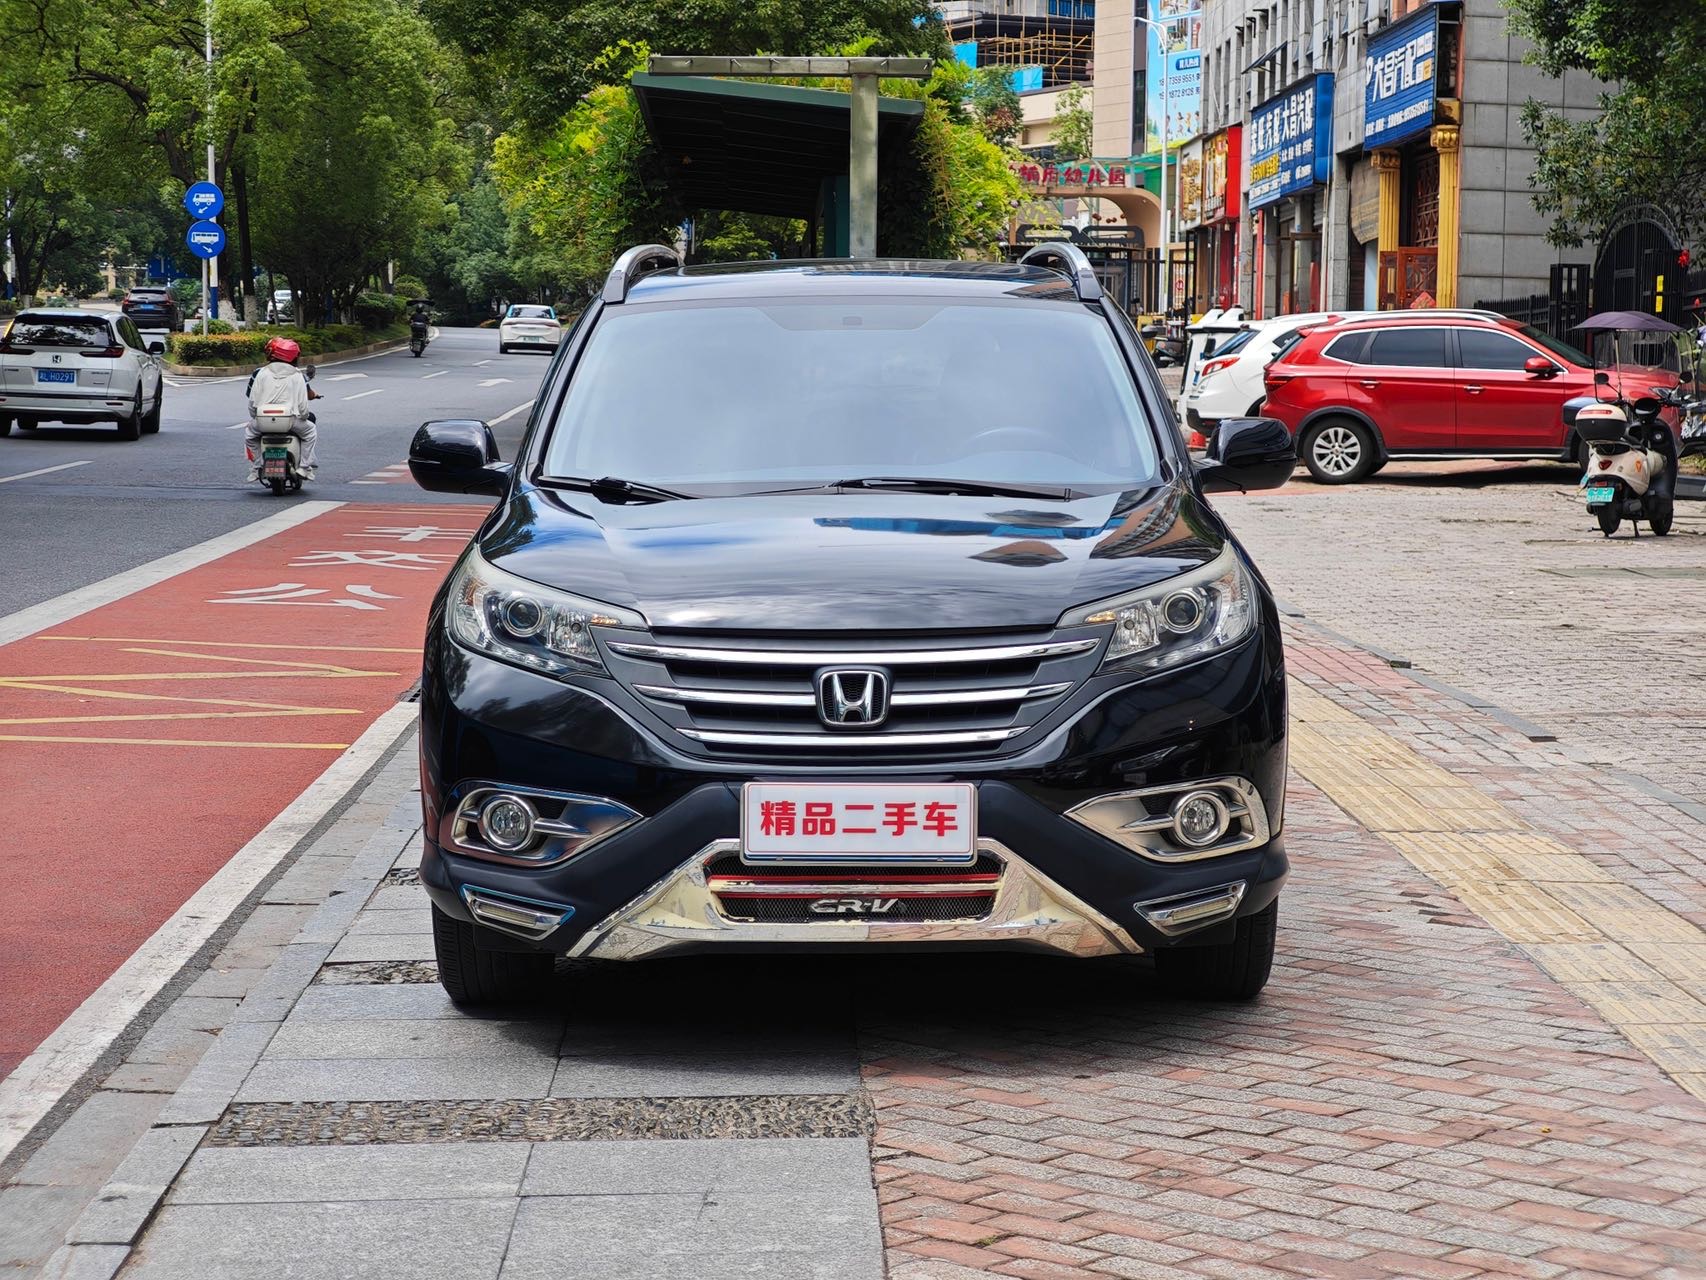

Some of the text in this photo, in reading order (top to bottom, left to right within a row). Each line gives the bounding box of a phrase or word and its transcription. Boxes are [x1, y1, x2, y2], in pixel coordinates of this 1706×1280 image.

[1372, 39, 1417, 103] 大昌汽配
[1281, 87, 1314, 142] 大昌汽配
[760, 800, 959, 838] 精品二手车
[810, 897, 899, 914] CR-V
